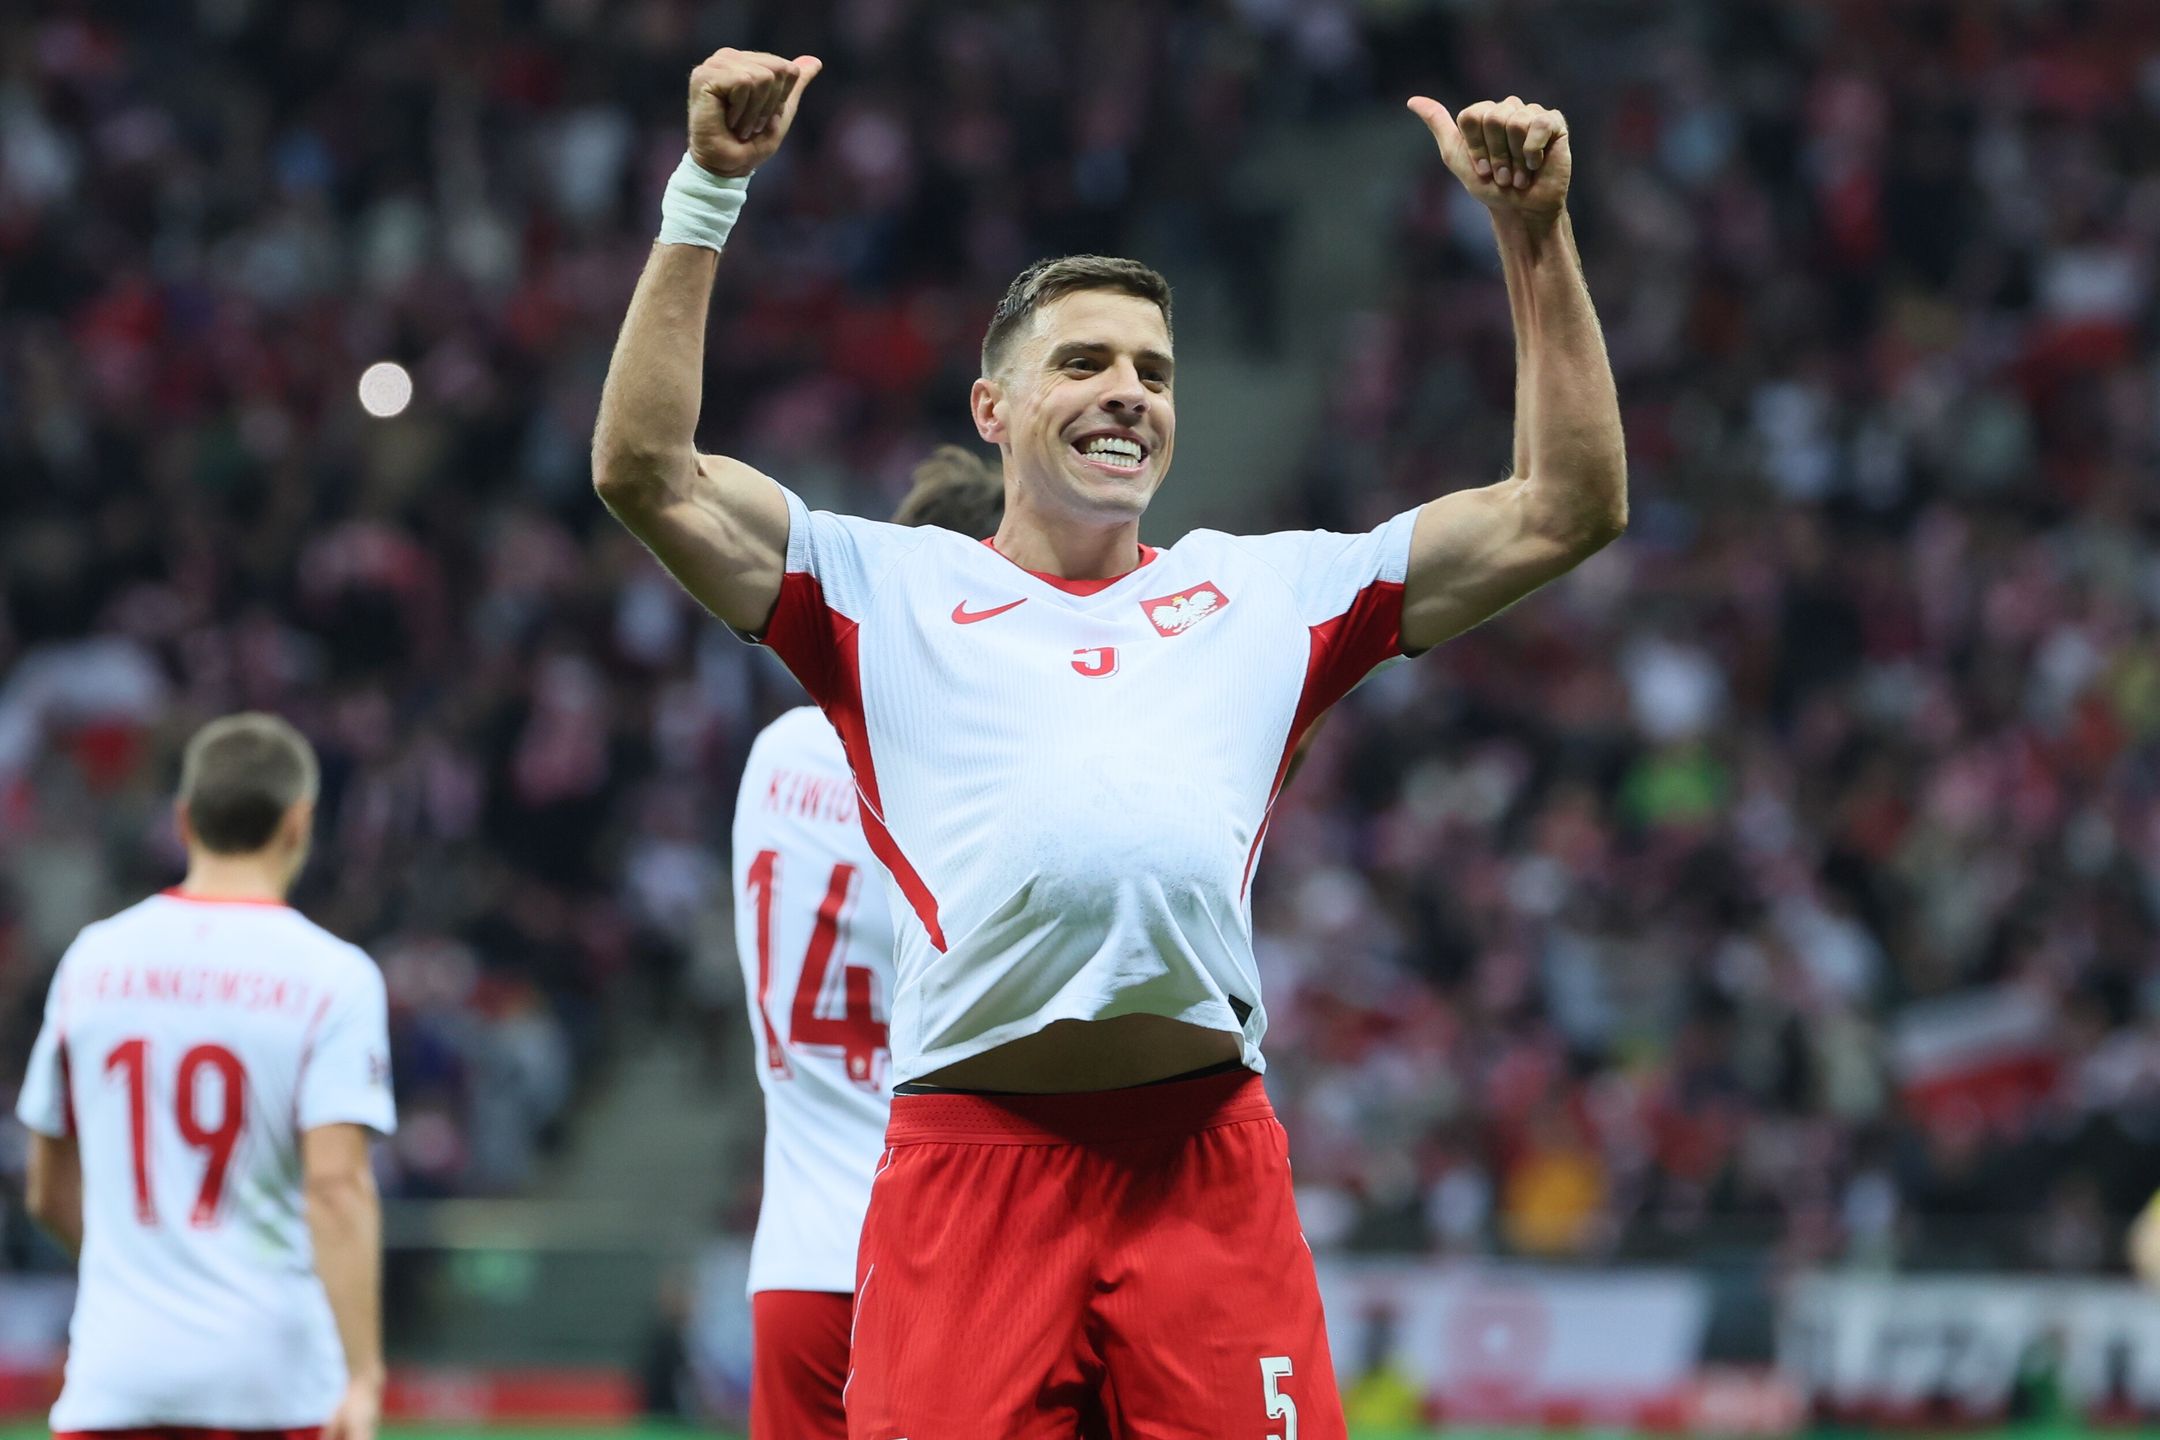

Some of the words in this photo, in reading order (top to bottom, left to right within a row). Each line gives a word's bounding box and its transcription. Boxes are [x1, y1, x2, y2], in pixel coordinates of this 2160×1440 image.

[762, 768, 860, 827] KIWIO
[746, 848, 891, 1092] 14
[104, 1036, 250, 1231] 19
[1259, 1356, 1298, 1440] 5
